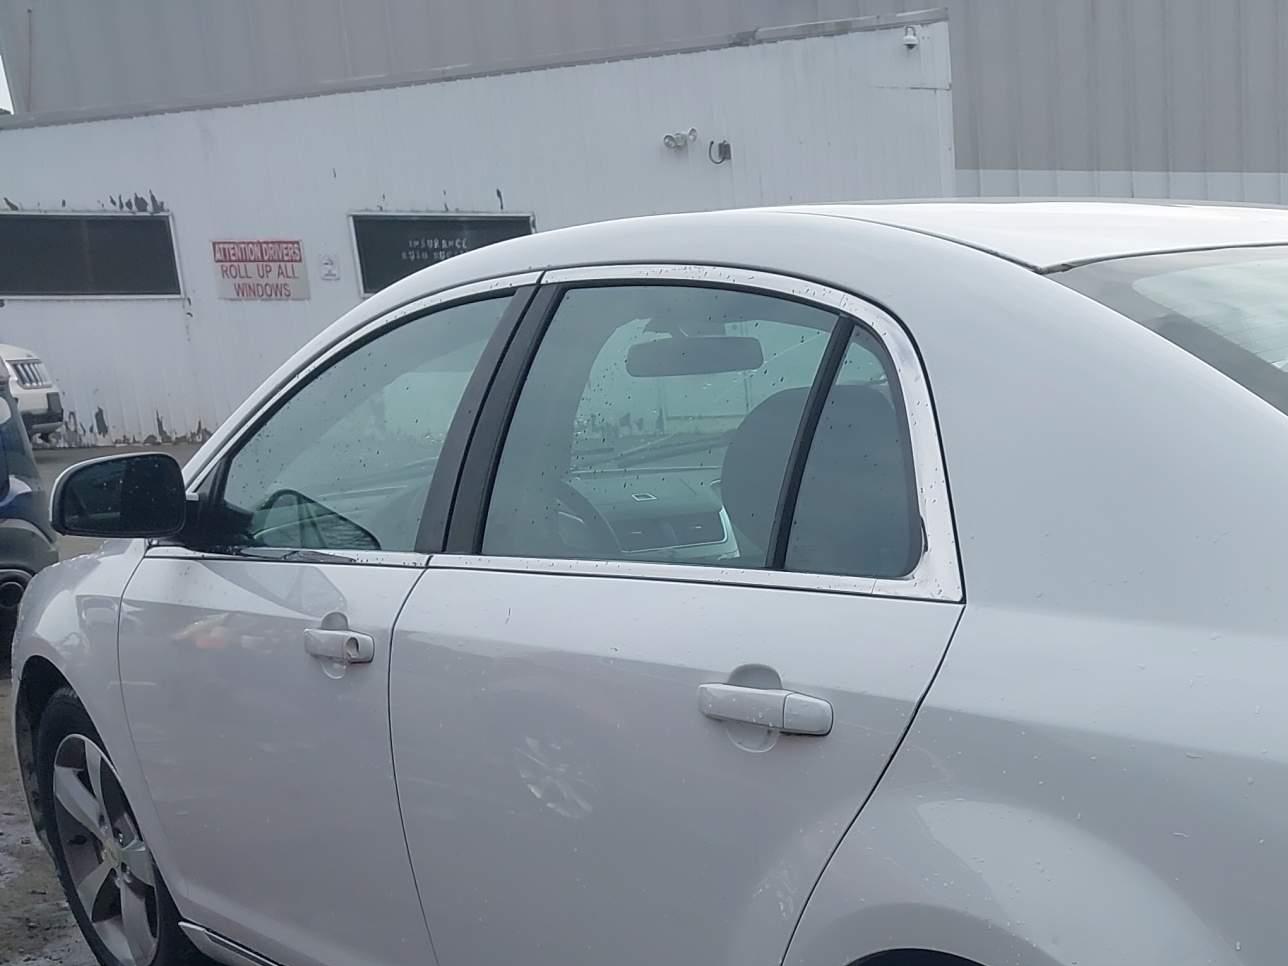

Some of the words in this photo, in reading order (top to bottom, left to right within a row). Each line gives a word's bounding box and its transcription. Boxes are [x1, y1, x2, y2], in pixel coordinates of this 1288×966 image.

[215, 242, 260, 261] ATTENTION
[261, 242, 300, 261] DRIVERS
[220, 263, 252, 279] ROLL
[257, 263, 273, 279] UP
[278, 263, 300, 279] ALL
[233, 282, 291, 298] WINDOWS
